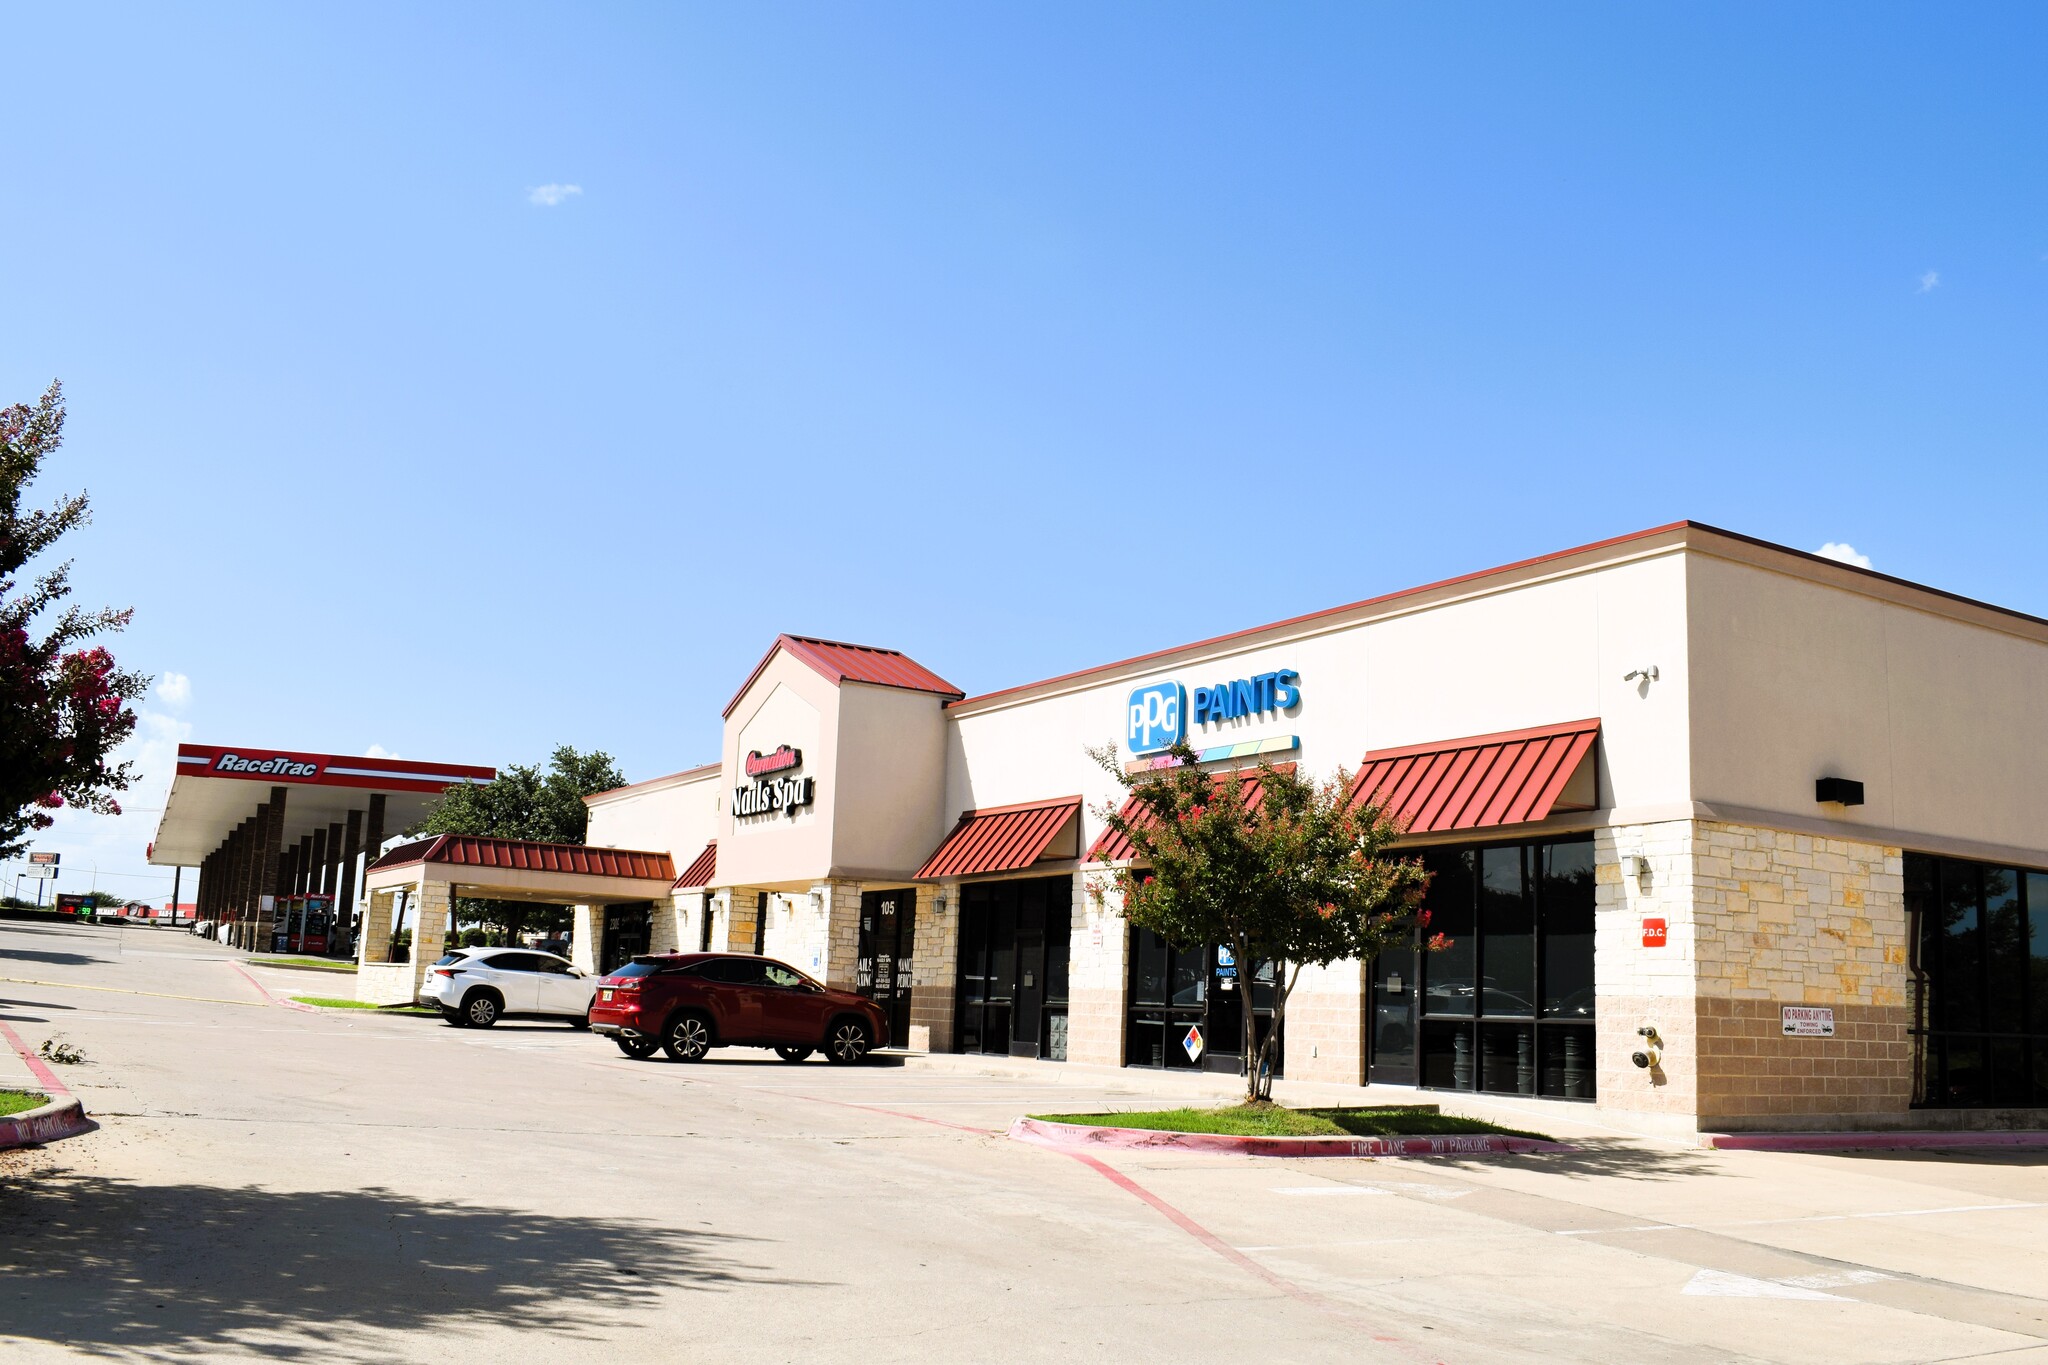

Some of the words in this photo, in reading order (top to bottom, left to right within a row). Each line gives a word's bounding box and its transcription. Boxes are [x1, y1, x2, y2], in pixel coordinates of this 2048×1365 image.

[1194, 669, 1299, 724] PAINTS
[1130, 691, 1176, 746] PPG
[216, 753, 318, 777] RaceTrac
[746, 744, 799, 777] Carnation
[731, 780, 770, 815] Nails
[773, 777, 807, 815] Spa
[881, 900, 895, 915] 105
[1643, 928, 1666, 937] F.D.C.
[1215, 968, 1237, 977] PAINTS
[1784, 1008, 1791, 1020] NO
[1791, 1009, 1811, 1020] PARKING
[1812, 1010, 1832, 1021] ANYTIME
[14, 1121, 31, 1140] NO
[33, 1116, 70, 1137] PARKING
[1351, 1141, 1376, 1156] FIRE
[1380, 1140, 1407, 1155] LANE
[1431, 1139, 1445, 1153] NO
[1450, 1138, 1491, 1152] PARKING
